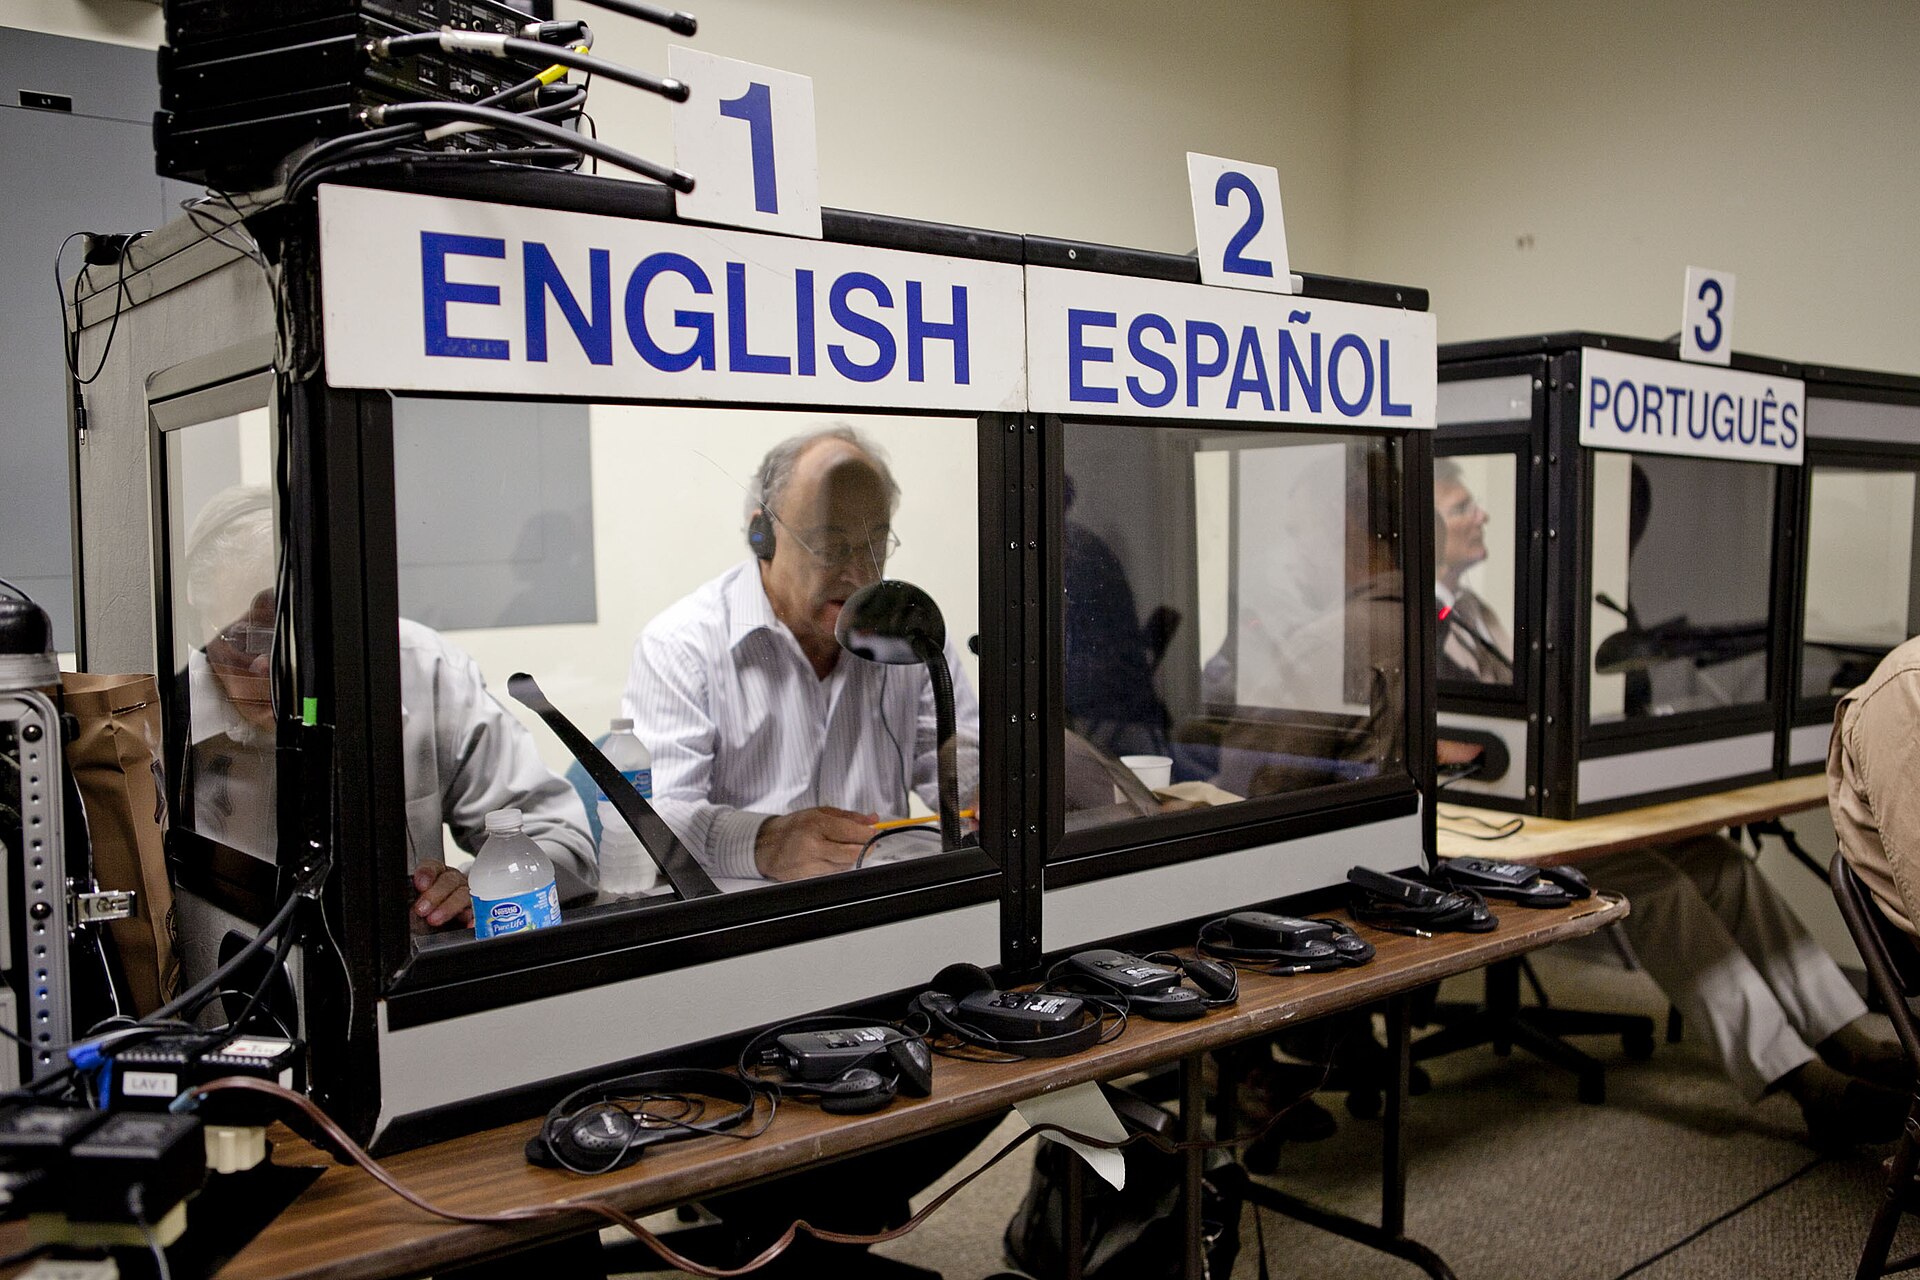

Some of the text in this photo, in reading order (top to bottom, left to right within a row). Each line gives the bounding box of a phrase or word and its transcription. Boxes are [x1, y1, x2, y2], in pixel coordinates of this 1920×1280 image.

[719, 82, 778, 215] 1
[1214, 171, 1274, 278] 2
[420, 230, 971, 385] ENGLISH
[1694, 278, 1723, 352] 3
[1067, 308, 1413, 418] ESPAÑOL
[1589, 375, 1799, 449] PORTUGUÊS
